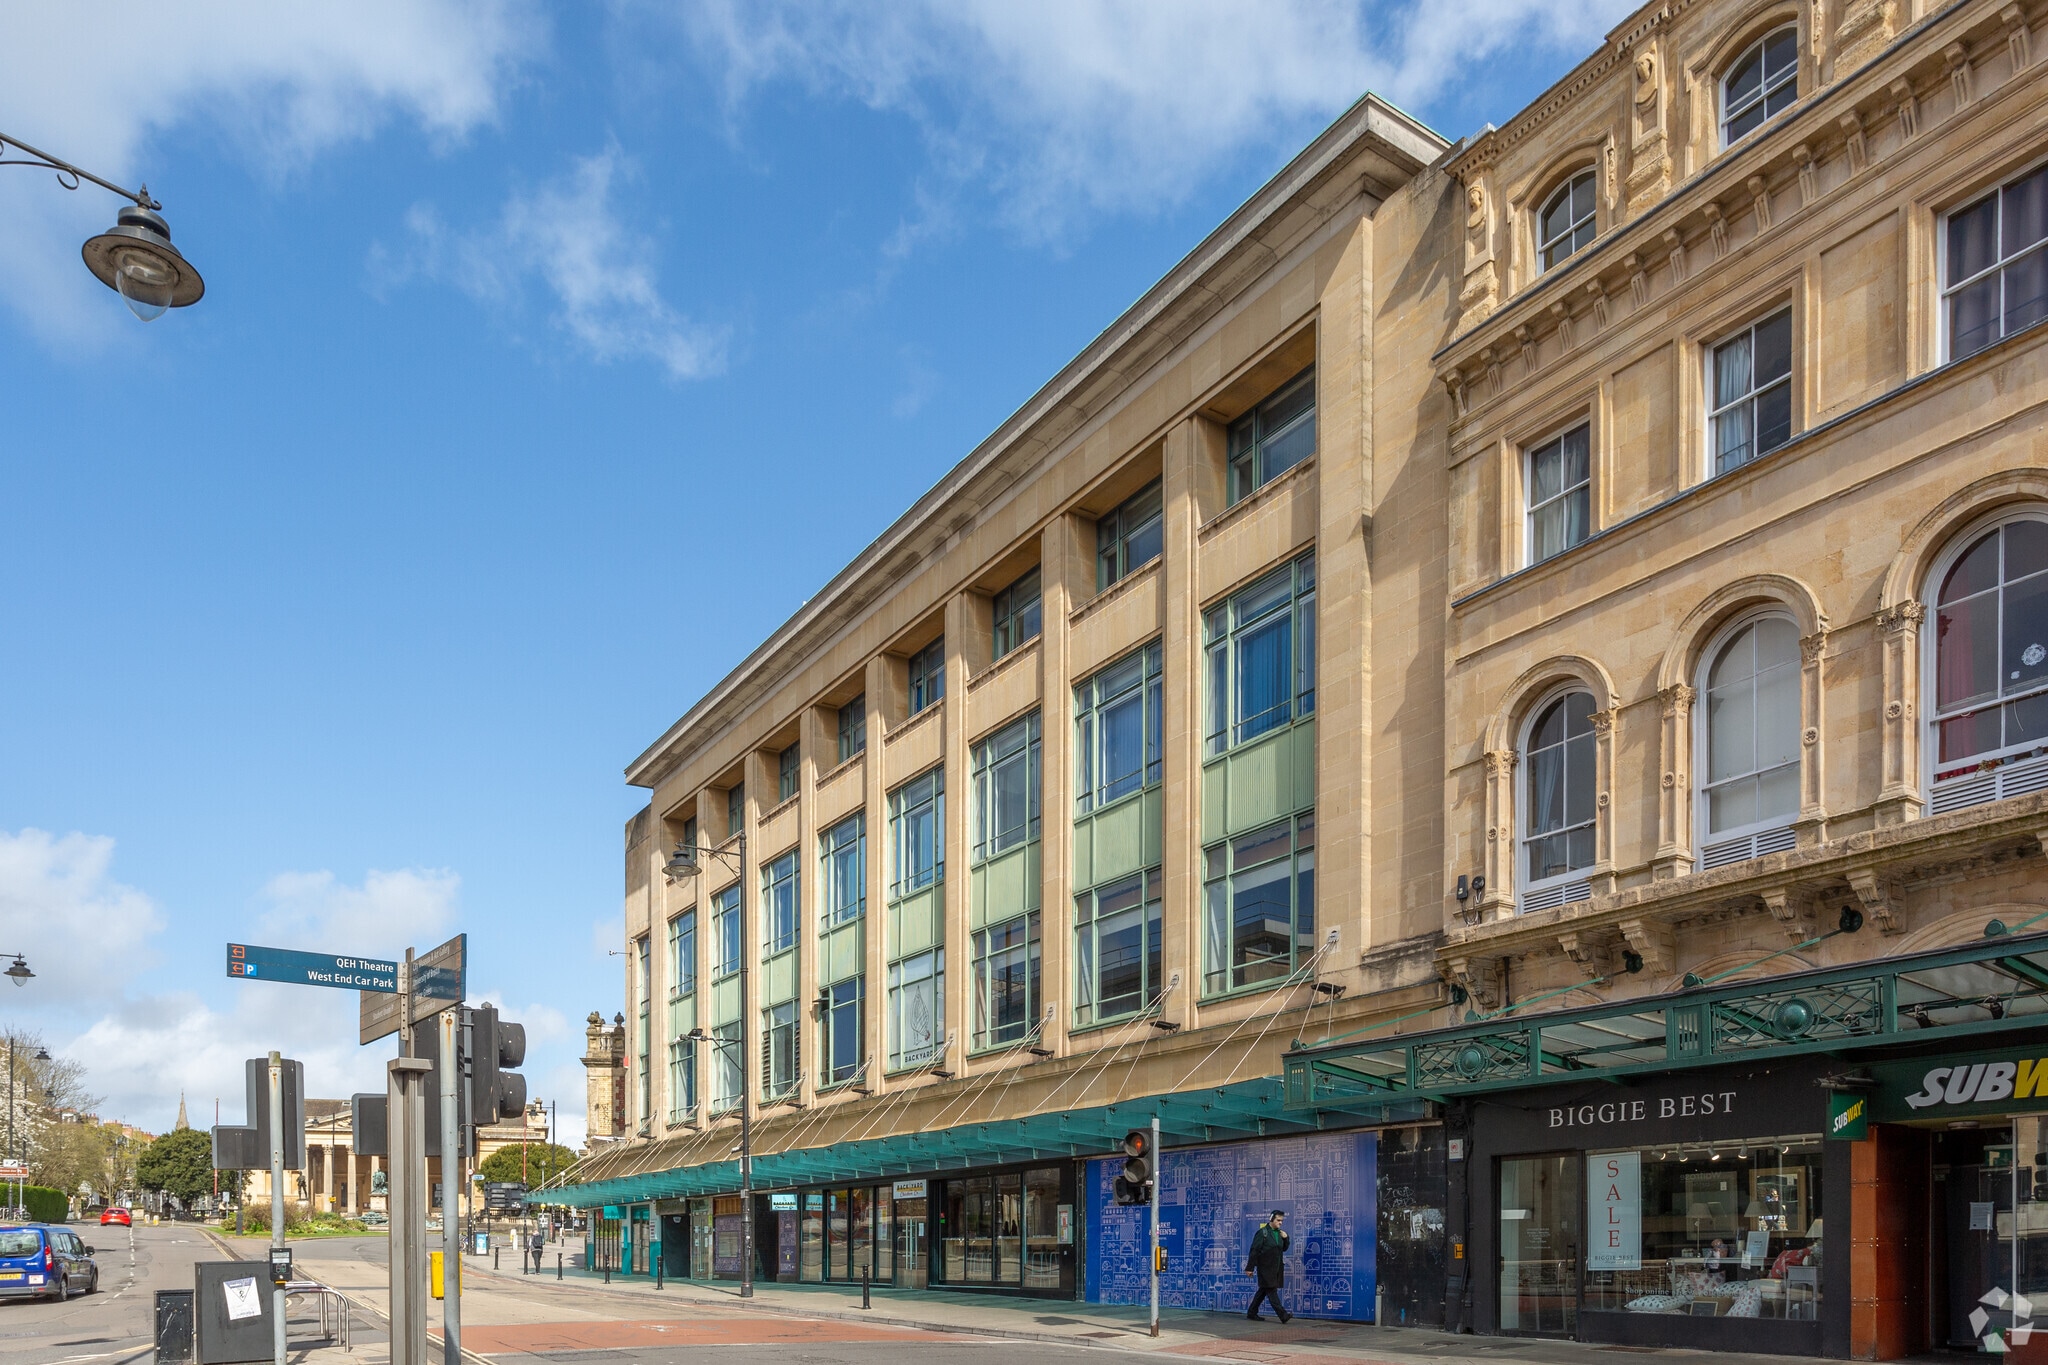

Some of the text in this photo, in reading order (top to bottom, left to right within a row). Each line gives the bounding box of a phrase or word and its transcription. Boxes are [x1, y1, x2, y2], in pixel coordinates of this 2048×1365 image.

[246, 964, 254, 975] P
[336, 957, 394, 973] QEH Theatre
[307, 970, 394, 989] West End Car Park
[1904, 1057, 2048, 1110] SUBW
[1549, 1091, 1737, 1128] BIGGIE BEST
[1832, 1098, 1864, 1133] SUBWAY
[1606, 1159, 1622, 1248] SALE
[1624, 1287, 1643, 1297] Shop
[1645, 1287, 1670, 1296] online
